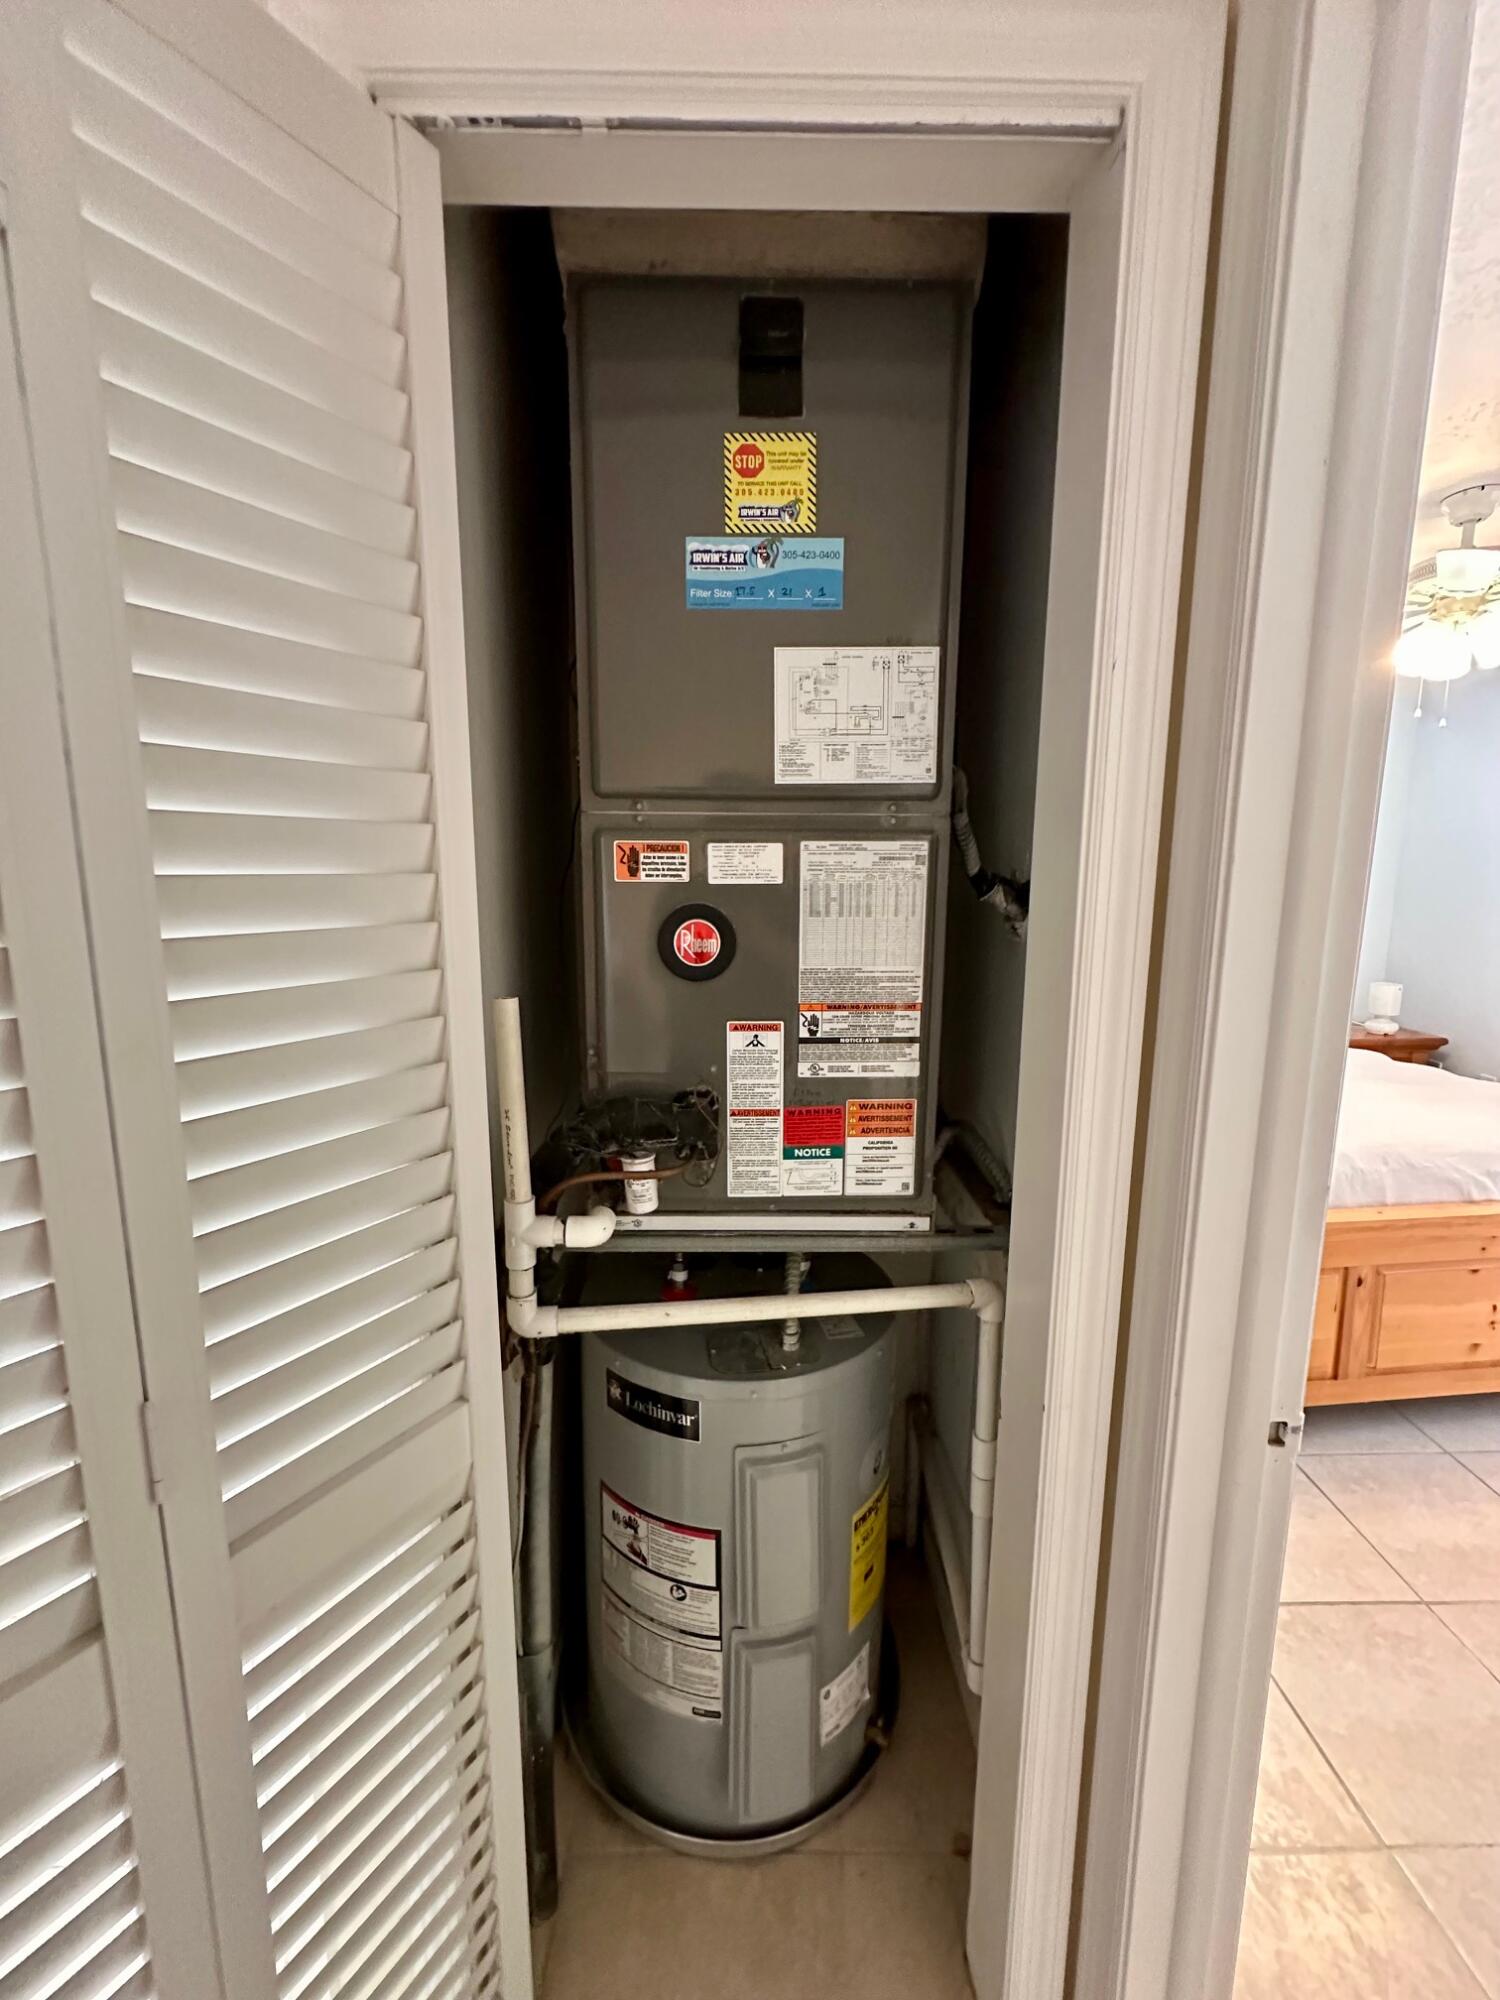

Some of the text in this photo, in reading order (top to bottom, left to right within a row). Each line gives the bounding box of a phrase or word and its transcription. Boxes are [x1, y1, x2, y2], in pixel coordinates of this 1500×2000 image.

[735, 454, 762, 469] STOP
[740, 508, 779, 517] IRWIN'S AIR
[693, 552, 745, 564] IRWIN'S AIR
[782, 550, 840, 560] 305-423-0400
[690, 588, 711, 598] Filter
[768, 589, 775, 598] X
[805, 589, 812, 598] X
[680, 923, 717, 959] Rheem
[787, 1107, 841, 1116] WARNING
[861, 1126, 910, 1134] ADVERTENCIA
[794, 1148, 831, 1156] NOTICE
[625, 1391, 695, 1427] Lochinvar
